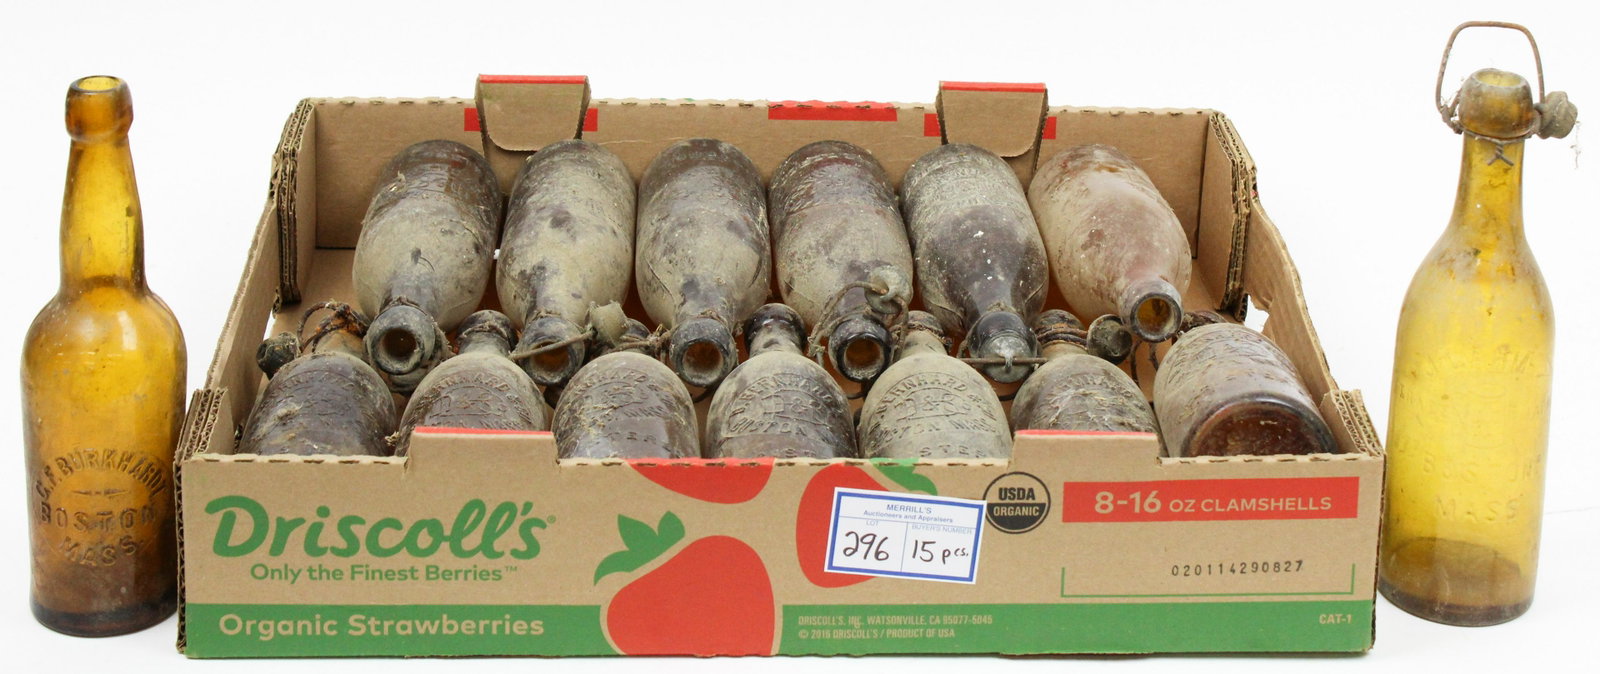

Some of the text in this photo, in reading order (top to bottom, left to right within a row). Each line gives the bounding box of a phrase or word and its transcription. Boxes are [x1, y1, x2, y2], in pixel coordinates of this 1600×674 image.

[999, 487, 1036, 501] USDA
[886, 503, 932, 514] MERRILL'S
[1094, 490, 1332, 514] 8-16 OZ CLAMSHELLS
[40, 501, 157, 531] BOSTON
[863, 510, 902, 520] Auctioneers
[918, 514, 954, 524] Appraisers
[993, 505, 1040, 517] ORGANIC
[943, 526, 973, 535] NUMBER
[842, 531, 890, 561] 296
[912, 539, 937, 562] 15
[250, 563, 302, 585] Only
[307, 564, 344, 582] the
[350, 564, 420, 582] Finest
[1171, 559, 1304, 577] 020114290827
[929, 615, 941, 625] CA
[1319, 613, 1353, 625] CAT-1
[219, 614, 545, 641] Organic Strawberries
[833, 628, 879, 639] DRISCOLL'S
[886, 628, 924, 639] PRODUCT
[926, 628, 936, 638] OF
[938, 628, 956, 638] USA
